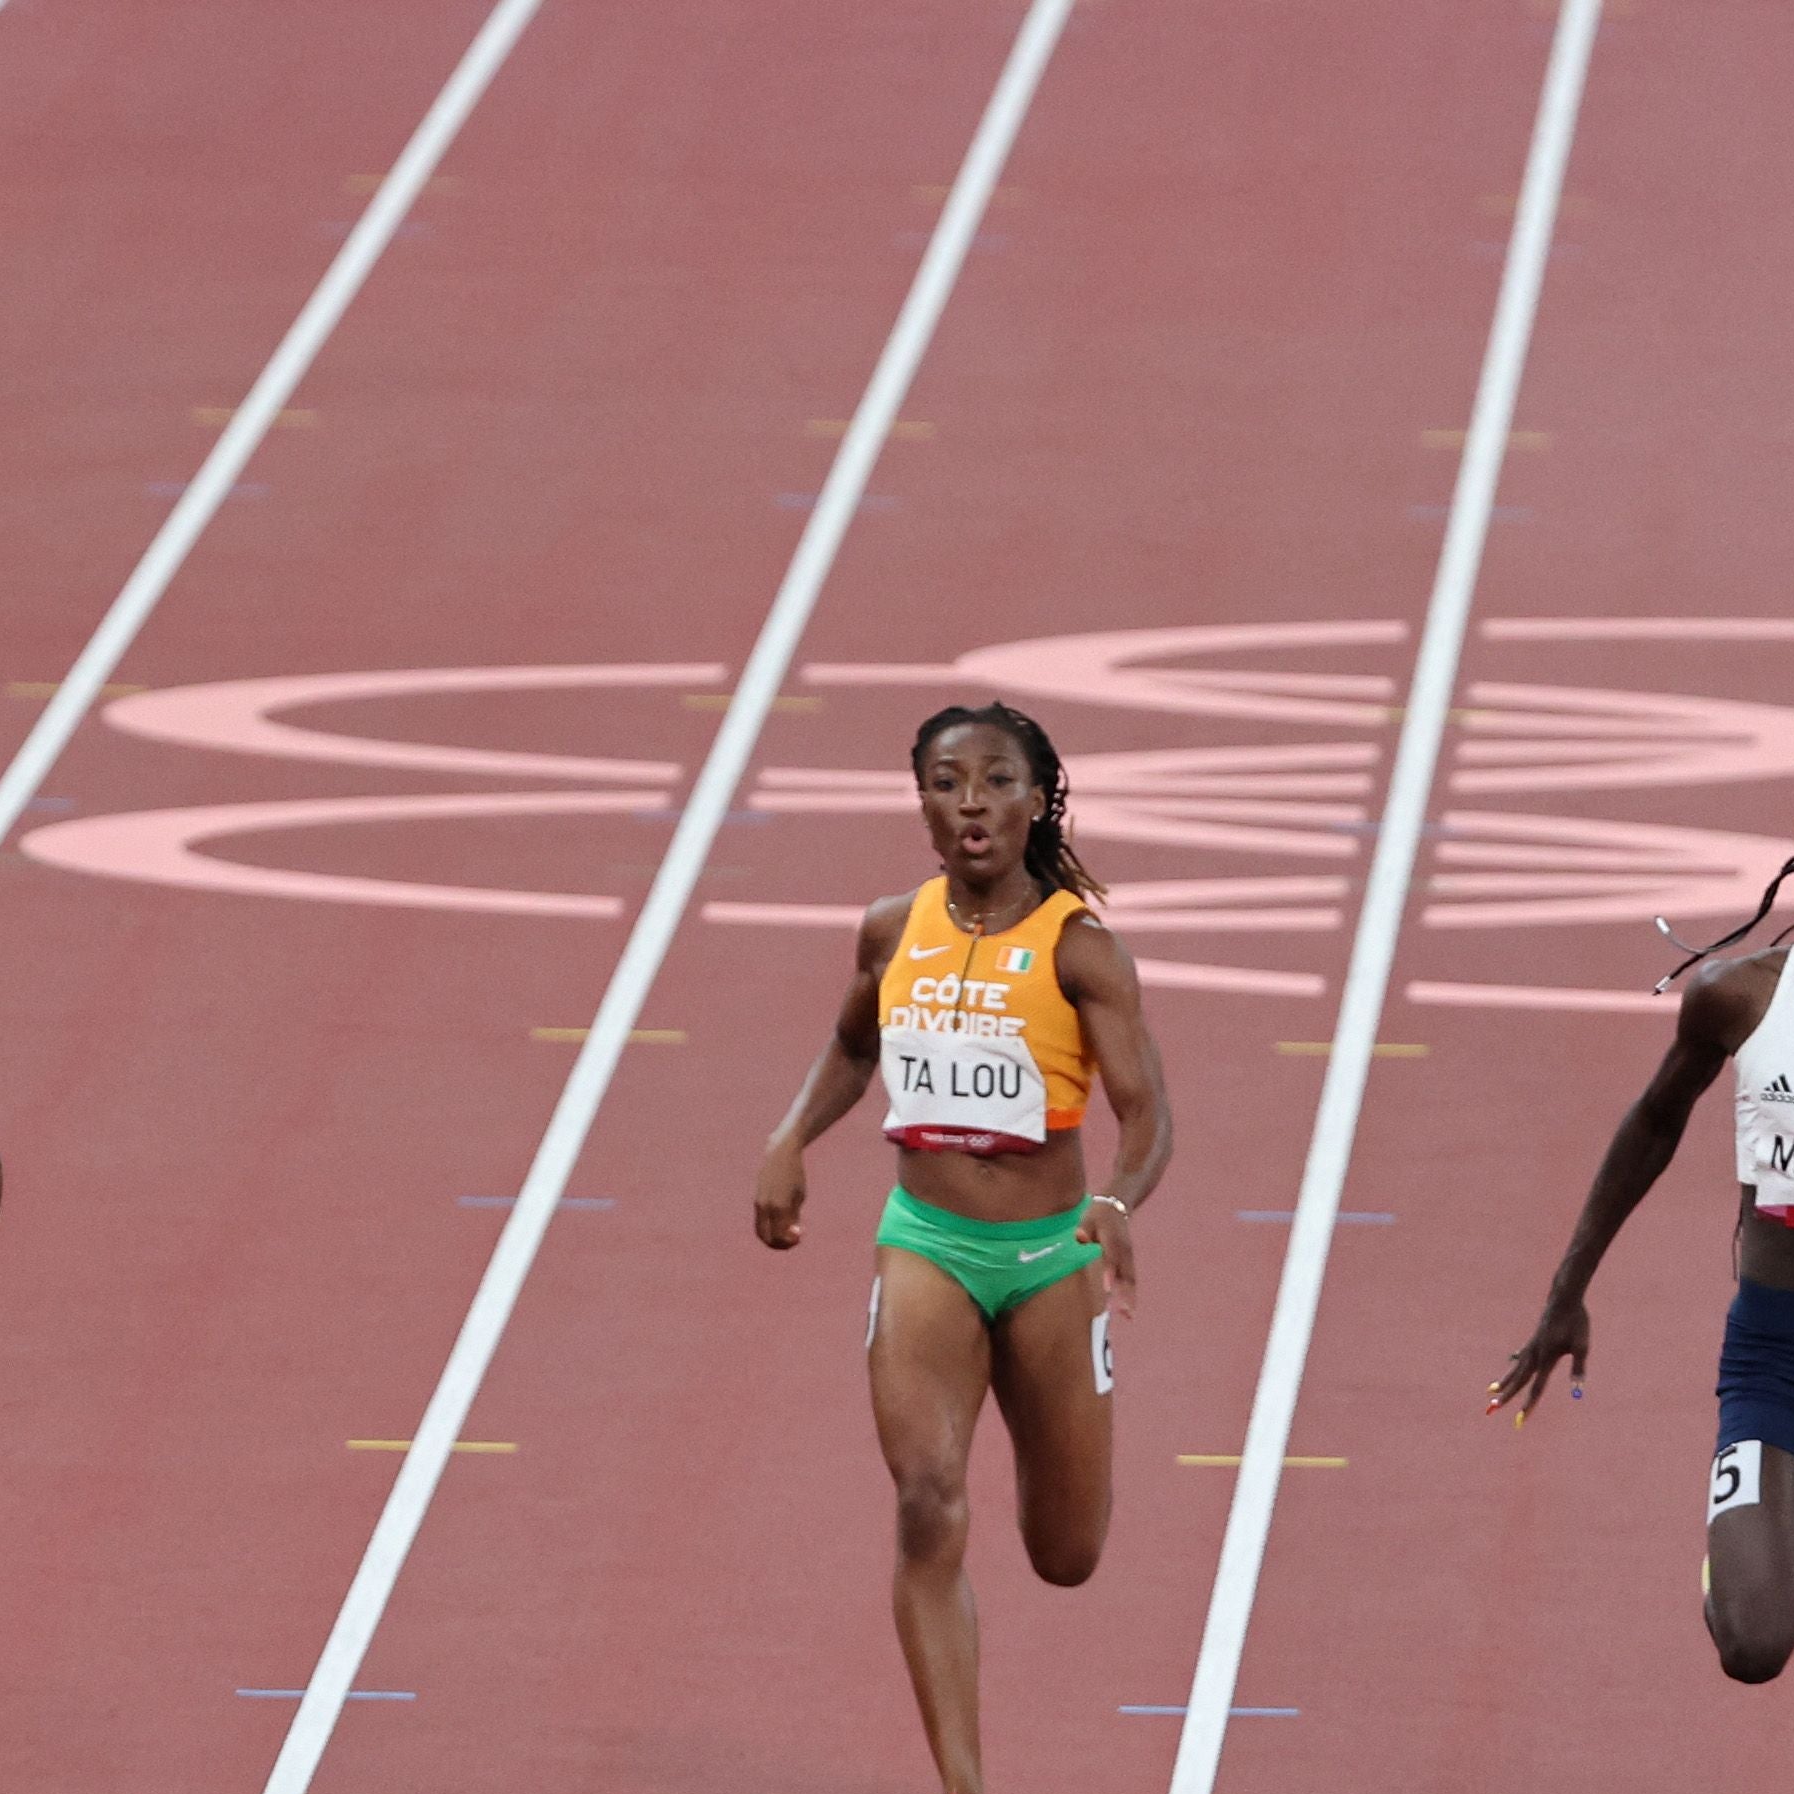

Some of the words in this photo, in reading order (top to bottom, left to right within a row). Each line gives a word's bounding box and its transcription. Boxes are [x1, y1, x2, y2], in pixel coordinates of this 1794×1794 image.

[910, 972, 1012, 1011] CÔTE
[900, 1055, 935, 1095] TA
[951, 1060, 1023, 1099] LOU
[1714, 1443, 1741, 1505] 5
